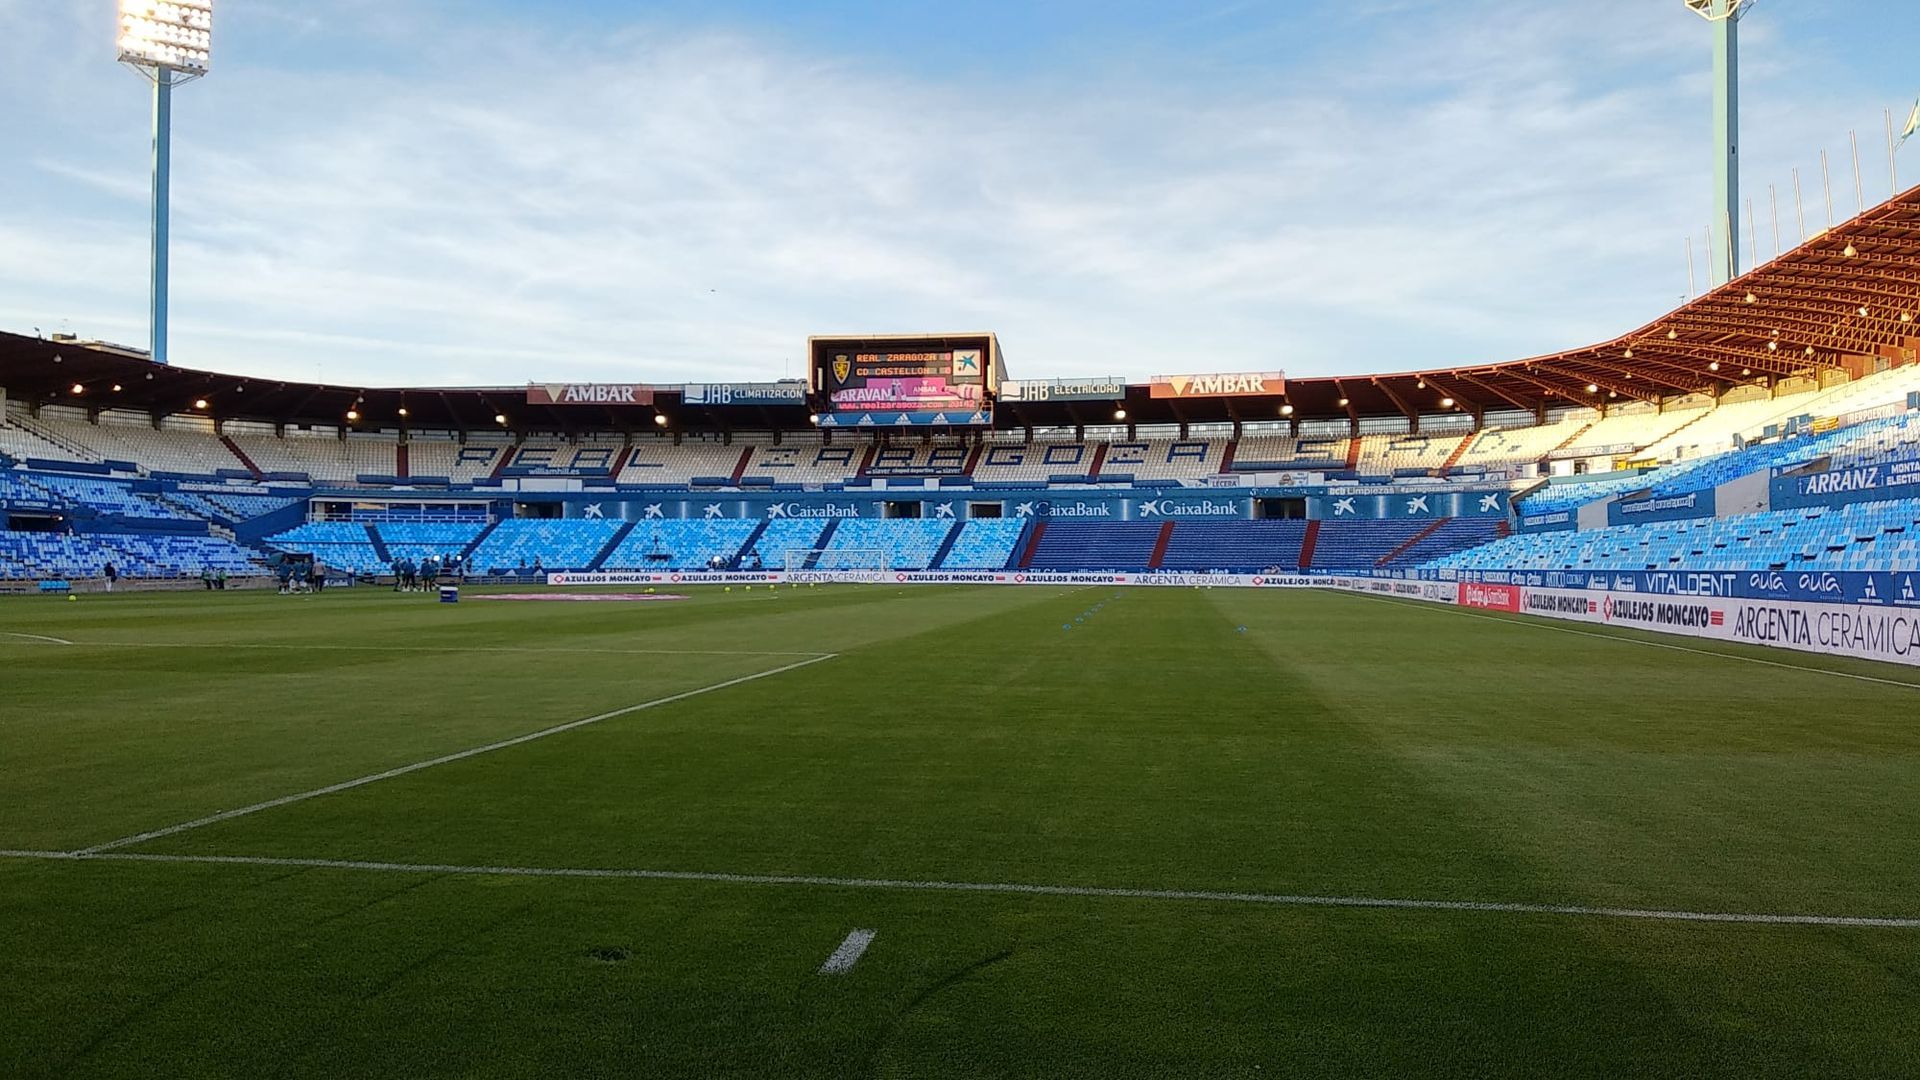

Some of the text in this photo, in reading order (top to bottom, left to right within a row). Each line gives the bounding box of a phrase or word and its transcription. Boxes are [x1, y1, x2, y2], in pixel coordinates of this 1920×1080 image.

[856, 354, 880, 363] REAL
[886, 353, 937, 362] ZARAGOZA
[1021, 380, 1120, 401] JAB ELECTRICIDAD
[1190, 374, 1266, 394] AMBAR
[564, 385, 636, 402] AMBAR
[704, 384, 803, 404] JAB CLIMATIZACIÓN
[528, 467, 582, 477] williamhill.es
[1806, 467, 1878, 495] ARRANZ
[786, 503, 859, 518] CaixaBank
[1038, 501, 1110, 517] CaixaBank
[1160, 500, 1238, 516] CaixaBank
[565, 574, 606, 582] AZULEJOS
[609, 574, 651, 582] MONCAYO
[681, 574, 767, 582] AZULEJOS MONCAYO
[786, 572, 833, 583] ARGENTA
[907, 574, 994, 582] AZULEJOS MONCAYO
[1026, 574, 1114, 583] AZULEJOS MONCAYO
[1134, 572, 1241, 585] ARGENTA CERÁMICA
[1264, 576, 1310, 585] AZULEJOS
[1646, 573, 1736, 597] VITALDENT
[1529, 592, 1588, 616] AZULEJOS MONCAYO
[1612, 599, 1709, 629] AZULEJOS MONCAYO
[1733, 605, 1920, 656] ARGENTA CERÁMICA
